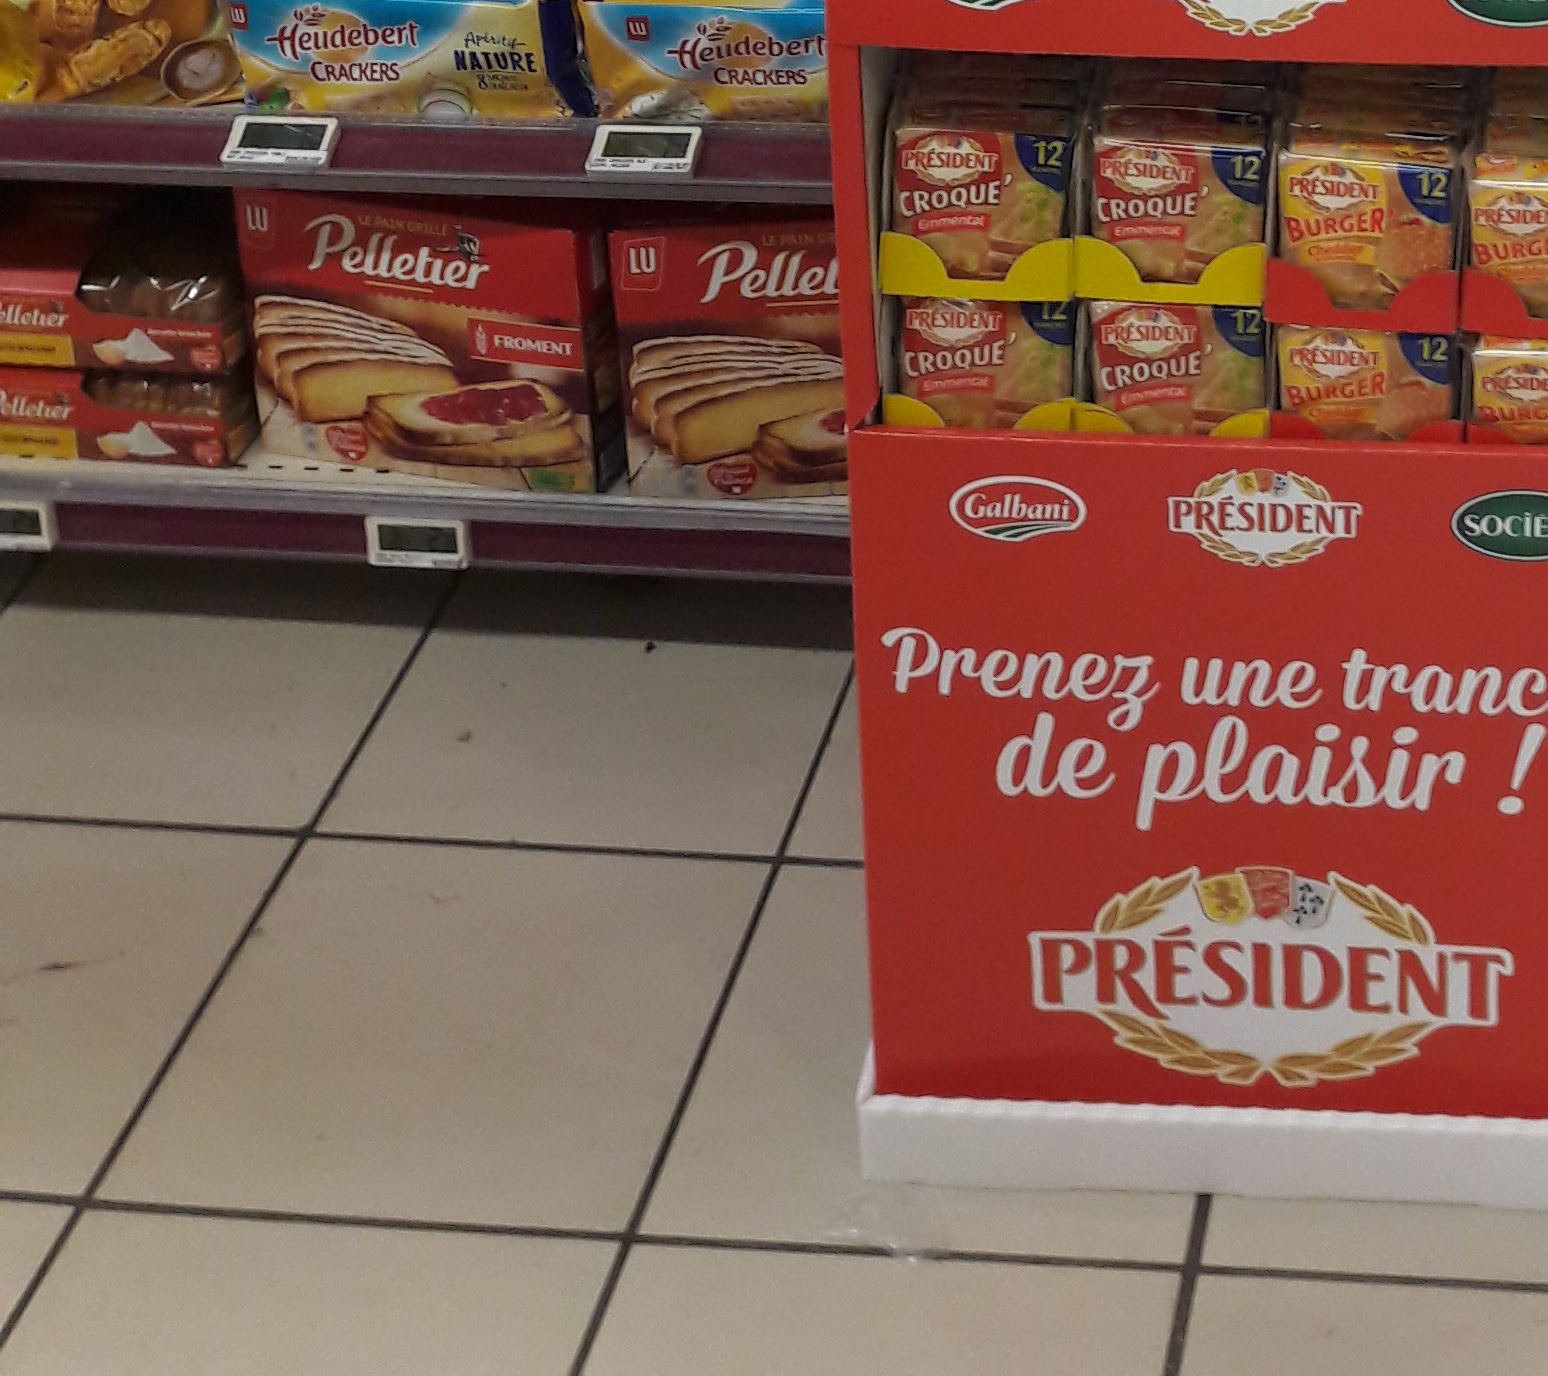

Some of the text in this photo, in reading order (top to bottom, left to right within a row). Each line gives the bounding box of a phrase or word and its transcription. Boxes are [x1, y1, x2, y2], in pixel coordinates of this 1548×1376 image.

[266, 21, 420, 60] Heudebert
[666, 36, 826, 71] Heudebert
[310, 60, 401, 84] CRACKERS
[454, 49, 537, 74] NATURE
[714, 66, 808, 87] CRACKERS
[1035, 141, 1063, 167] 12
[246, 205, 269, 232] LU
[305, 213, 491, 291] Pelletier
[629, 247, 656, 275] LU
[494, 334, 574, 357] FROMENT
[963, 489, 1071, 523] Galbani
[1170, 496, 1361, 540] PRÉSIDENT
[881, 626, 1160, 731] Prenez
[1179, 655, 1323, 710] une
[995, 711, 1547, 832] de plaisir !
[1039, 926, 1502, 1021] PRÉSIDENT
